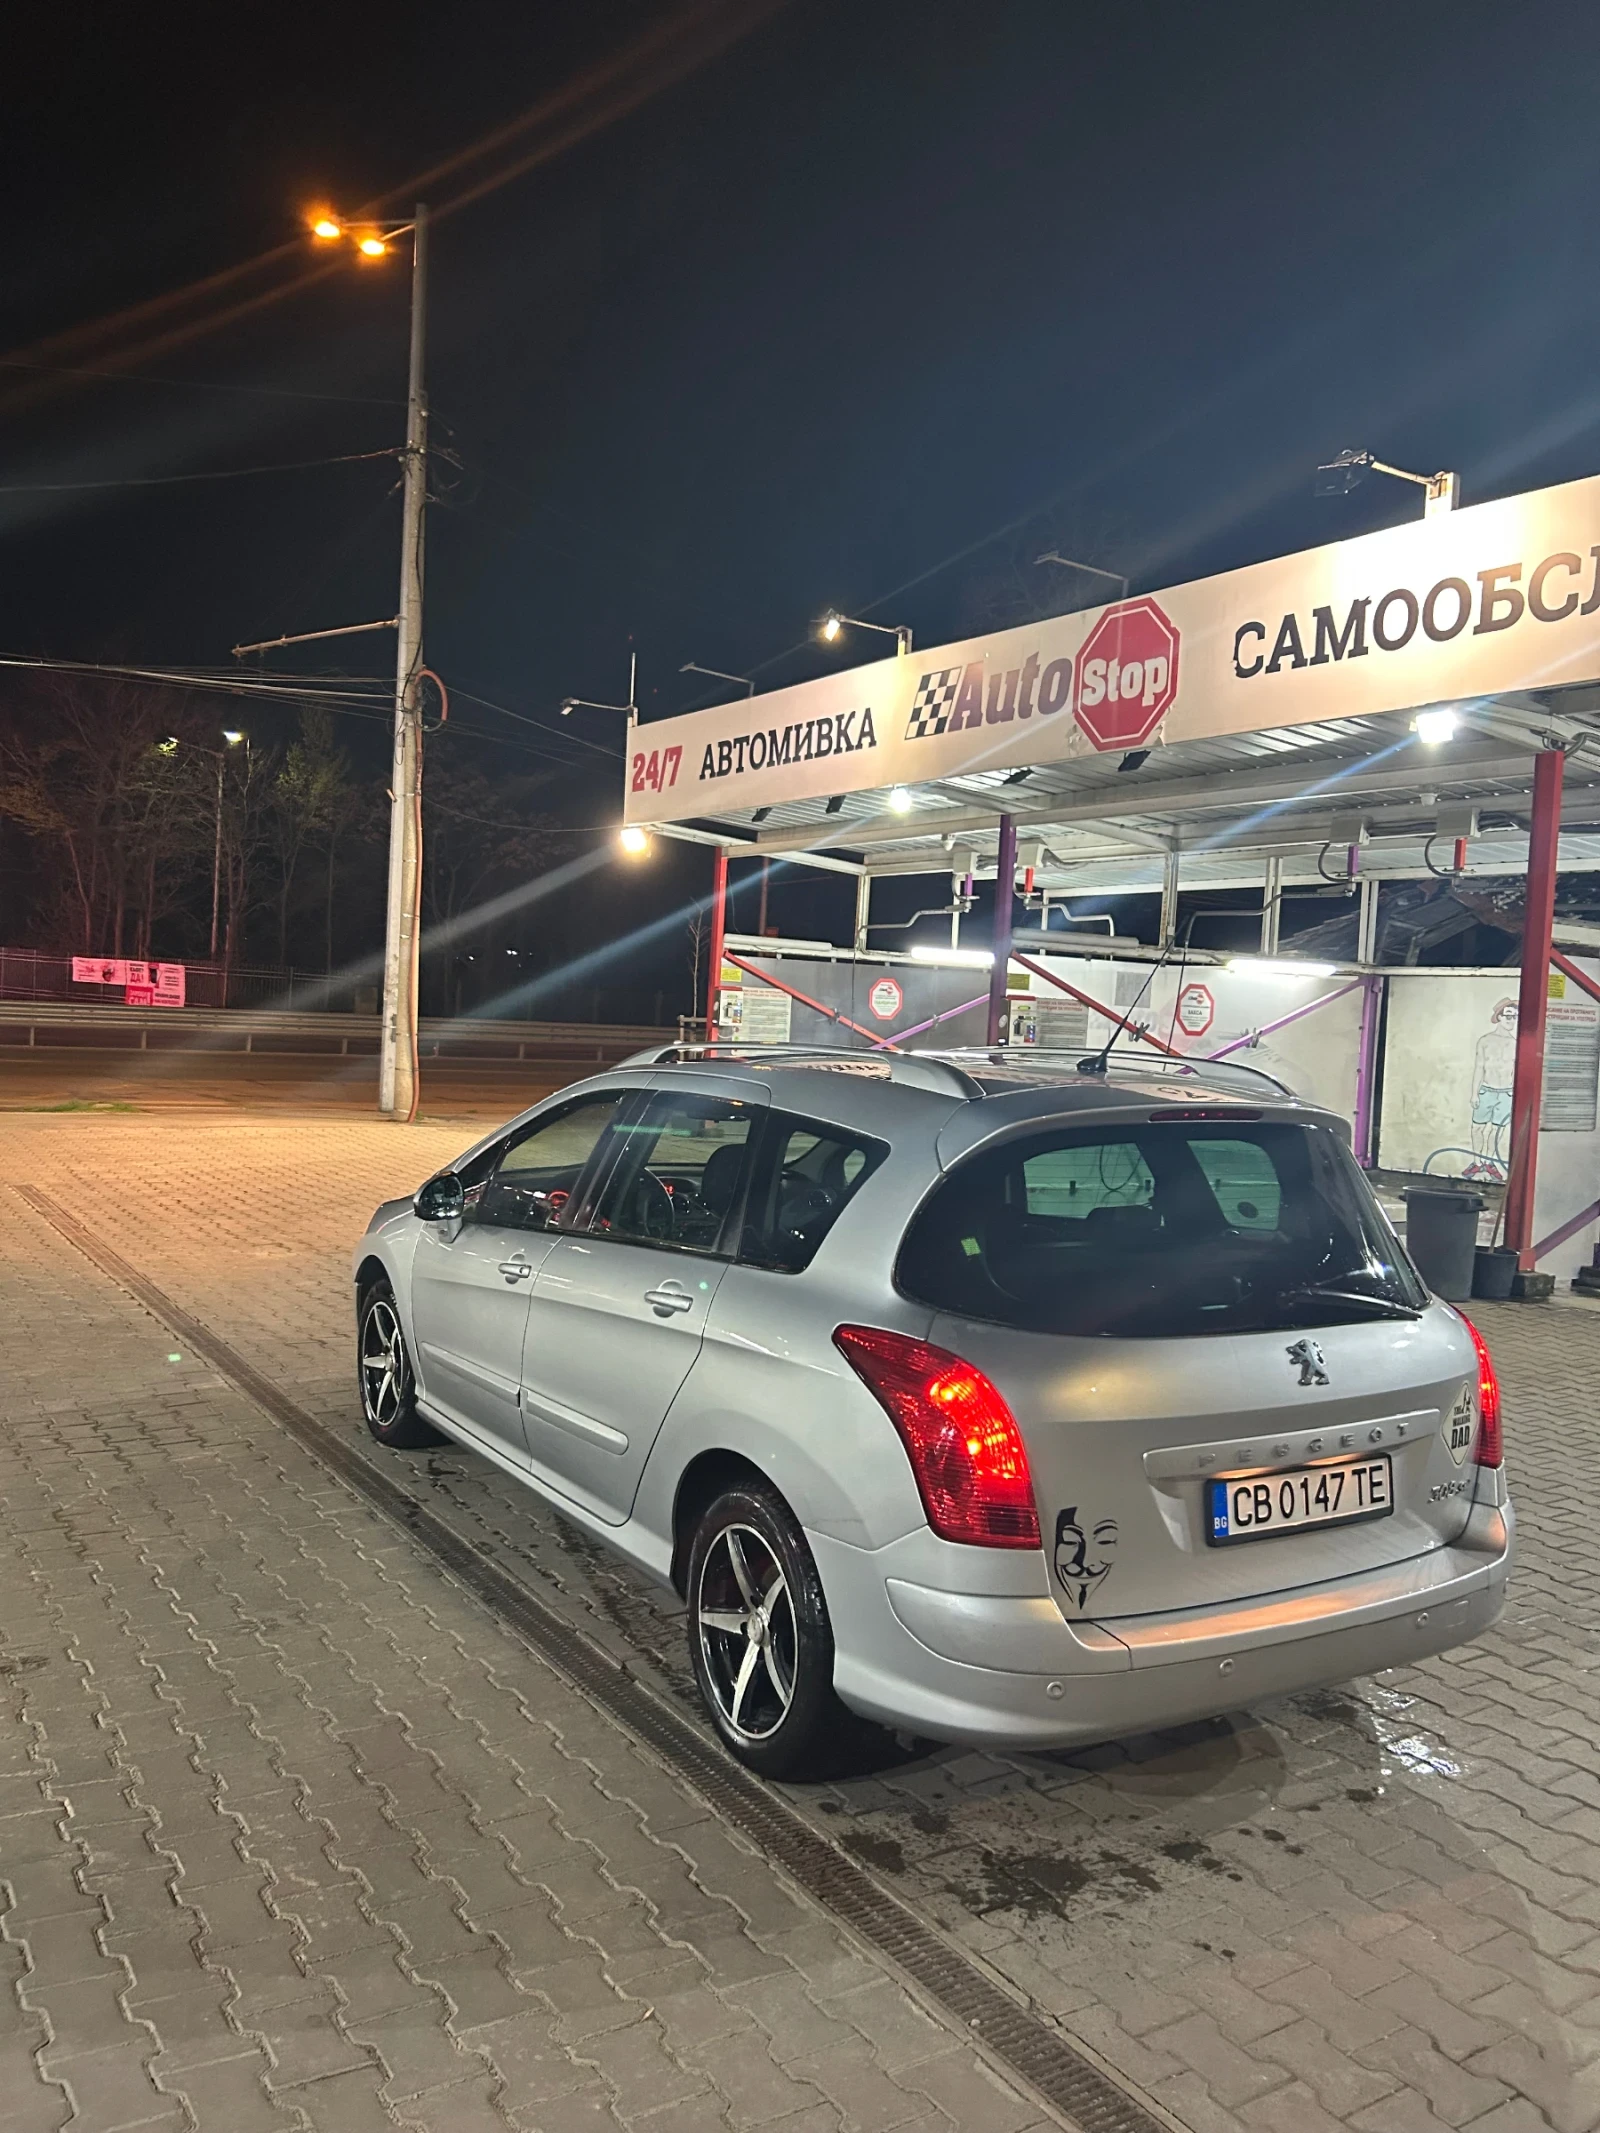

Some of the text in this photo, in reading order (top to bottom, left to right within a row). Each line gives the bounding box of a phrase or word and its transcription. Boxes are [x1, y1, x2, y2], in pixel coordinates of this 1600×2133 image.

[948, 652, 1169, 733] Auto Stop
[632, 707, 877, 793] 24/7 АВТОМИВКА
[1198, 1422, 1409, 1468] PEUGEOT
[1451, 1425, 1470, 1450] DAD
[1214, 1516, 1228, 1530] BG
